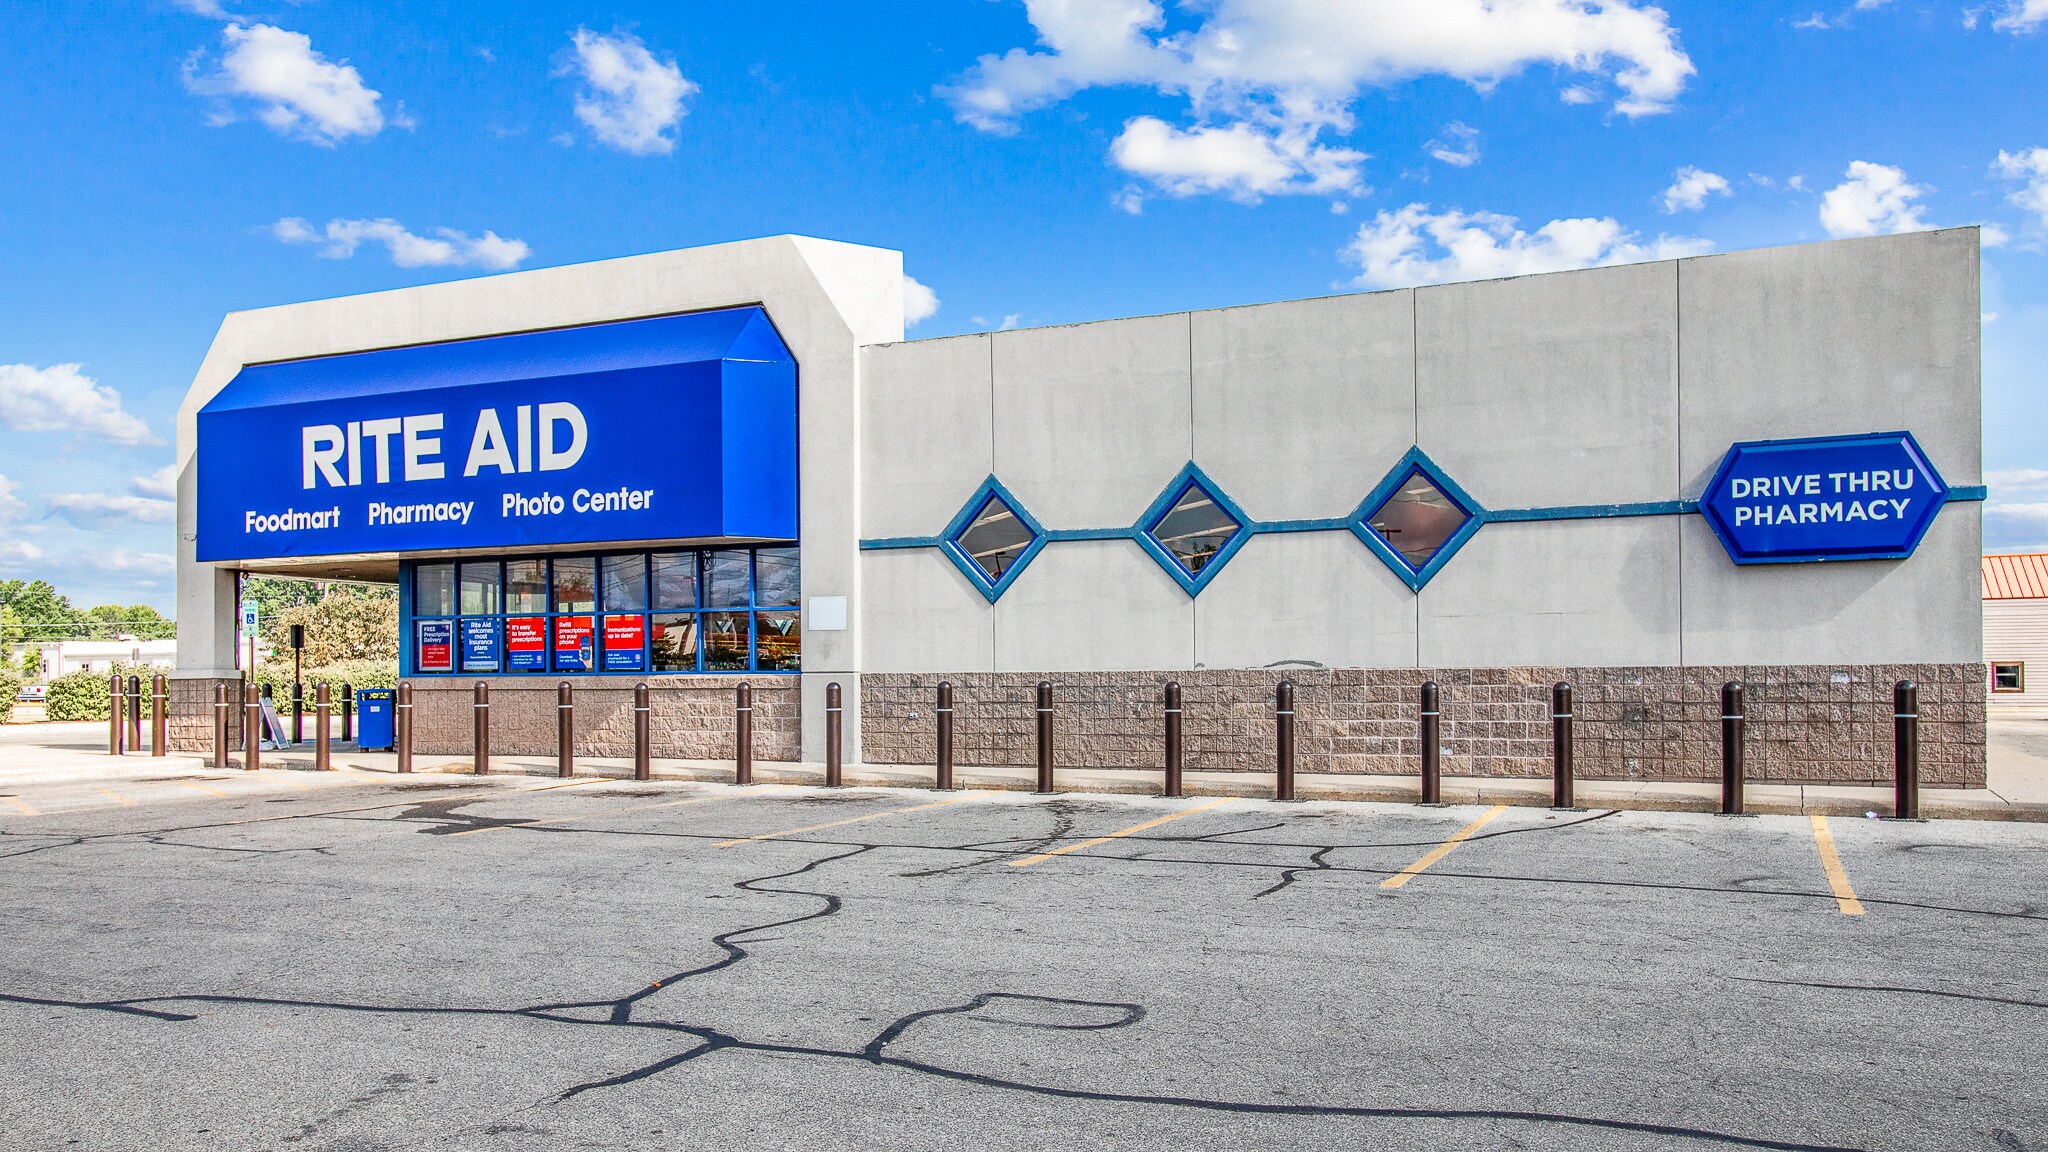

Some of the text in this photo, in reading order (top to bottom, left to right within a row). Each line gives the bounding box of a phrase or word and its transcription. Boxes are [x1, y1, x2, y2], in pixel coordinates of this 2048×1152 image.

[302, 401, 588, 490] RITE AID
[1731, 469, 1914, 499] DRIVE THRU
[368, 498, 474, 527] Pharmacy
[502, 487, 654, 518] Photo Center
[1735, 498, 1911, 526] PHARMACY
[245, 506, 340, 534] Foodmart
[511, 636, 543, 644] prescriptions
[559, 627, 590, 635] prescriptions
